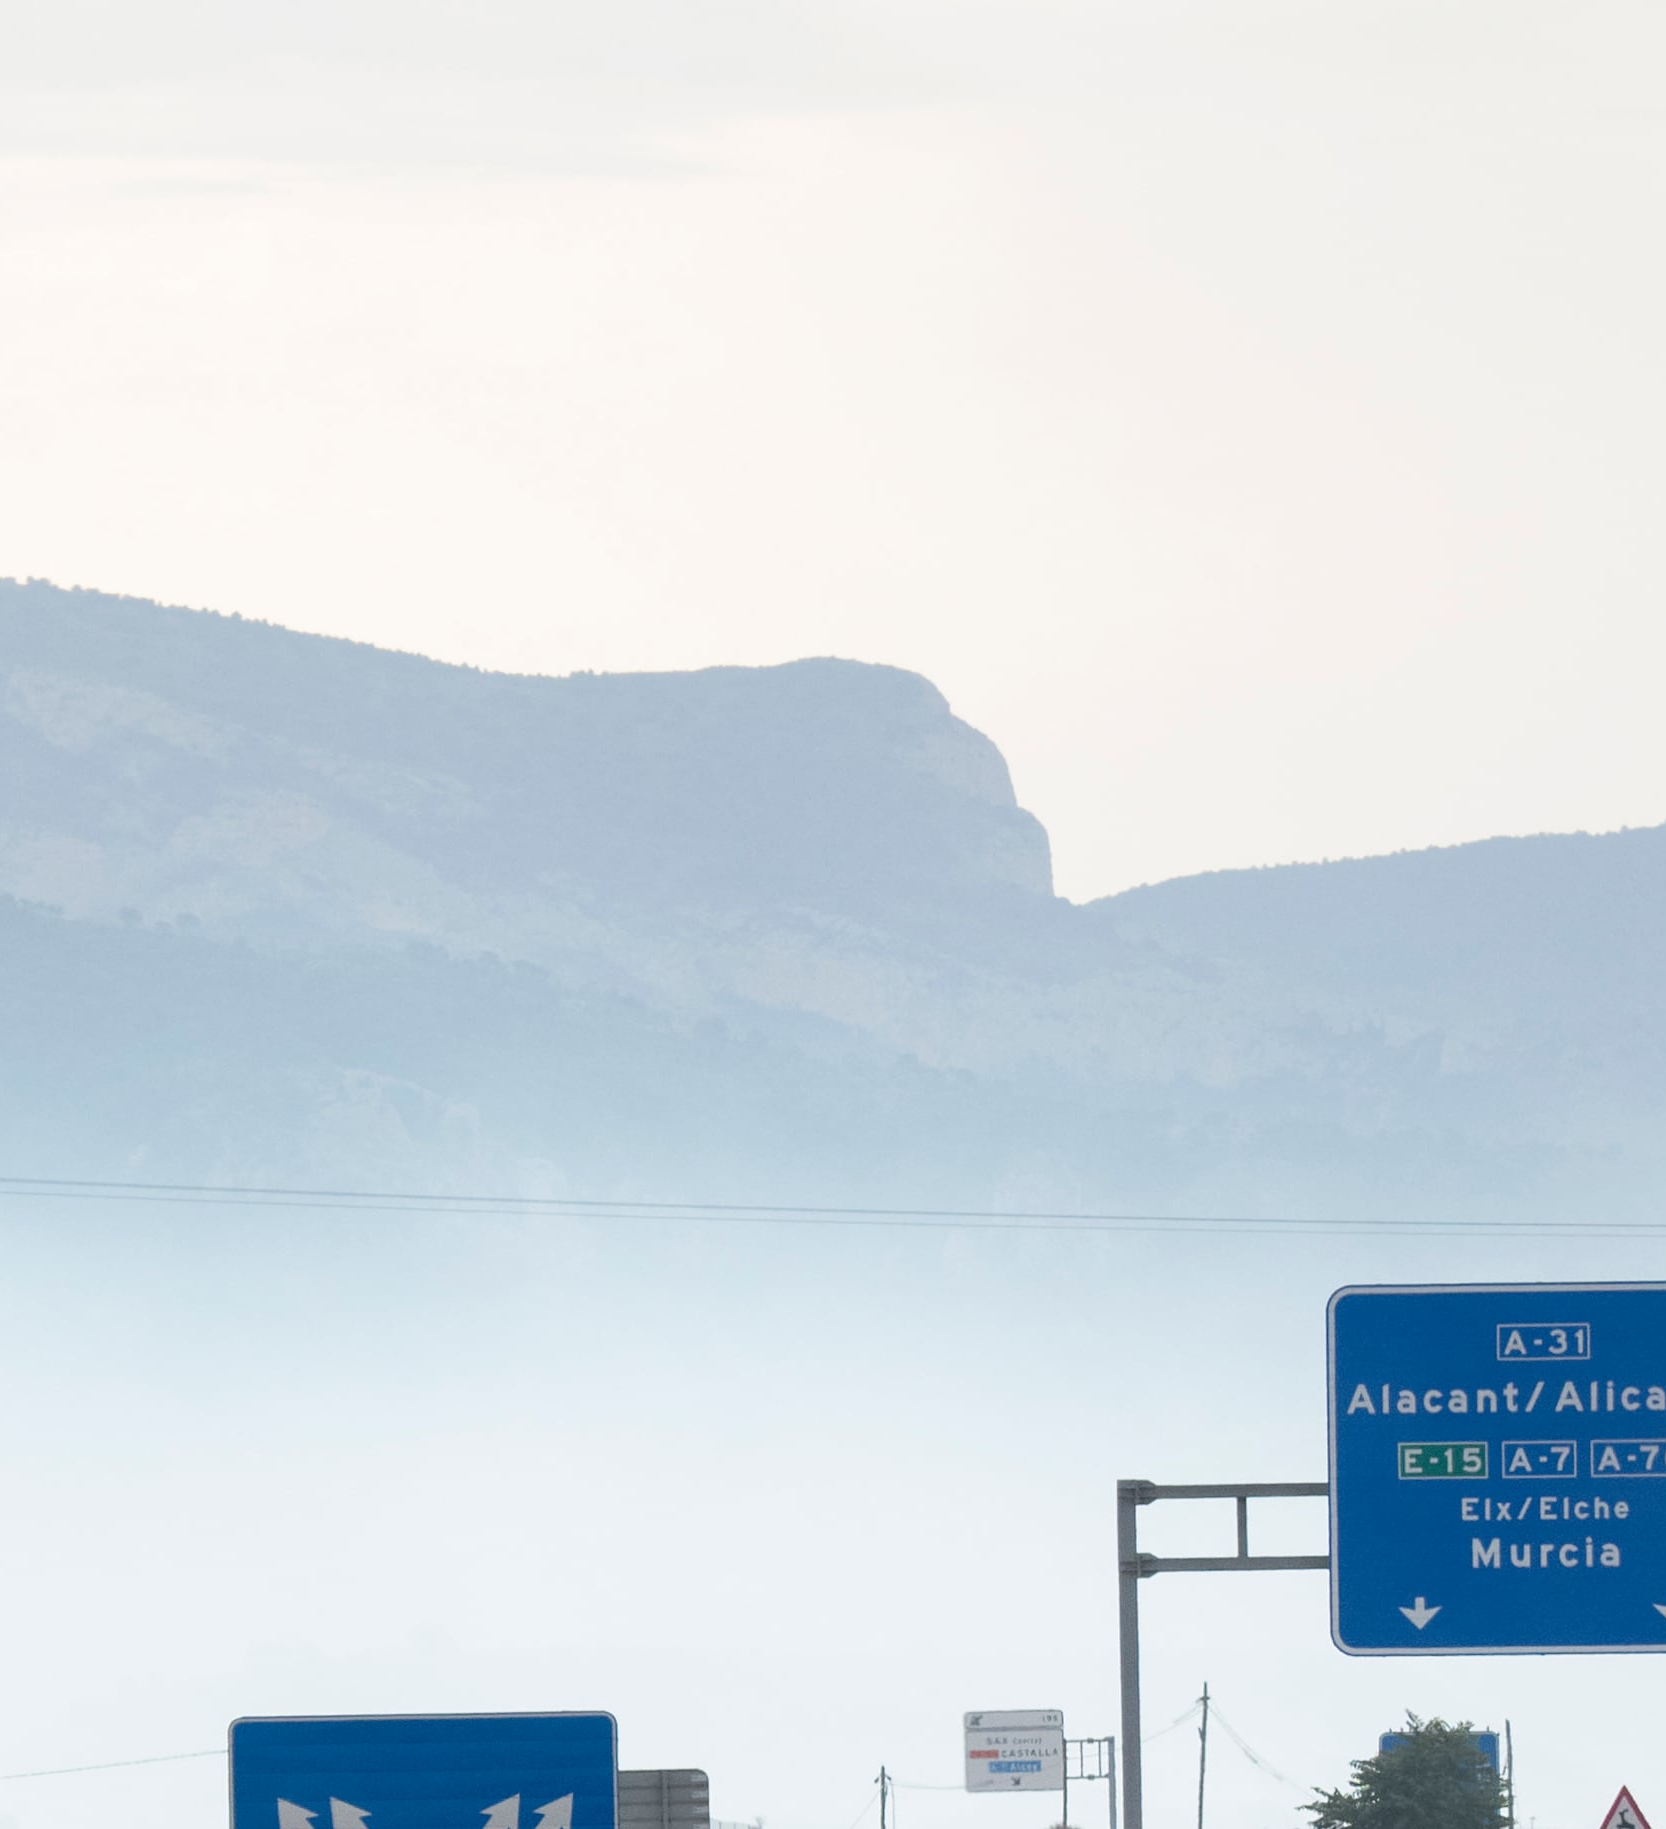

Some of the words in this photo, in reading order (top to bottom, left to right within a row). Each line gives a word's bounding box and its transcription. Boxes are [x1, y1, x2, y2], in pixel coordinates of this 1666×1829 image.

[1504, 1329, 1585, 1356] A-31
[1404, 1447, 1483, 1473] E-15
[1509, 1446, 1571, 1472] A-7
[1461, 1496, 1630, 1521] Elx/Elche
[1471, 1537, 1621, 1569] Murcia
[1001, 1748, 1058, 1758] CASTALLA
